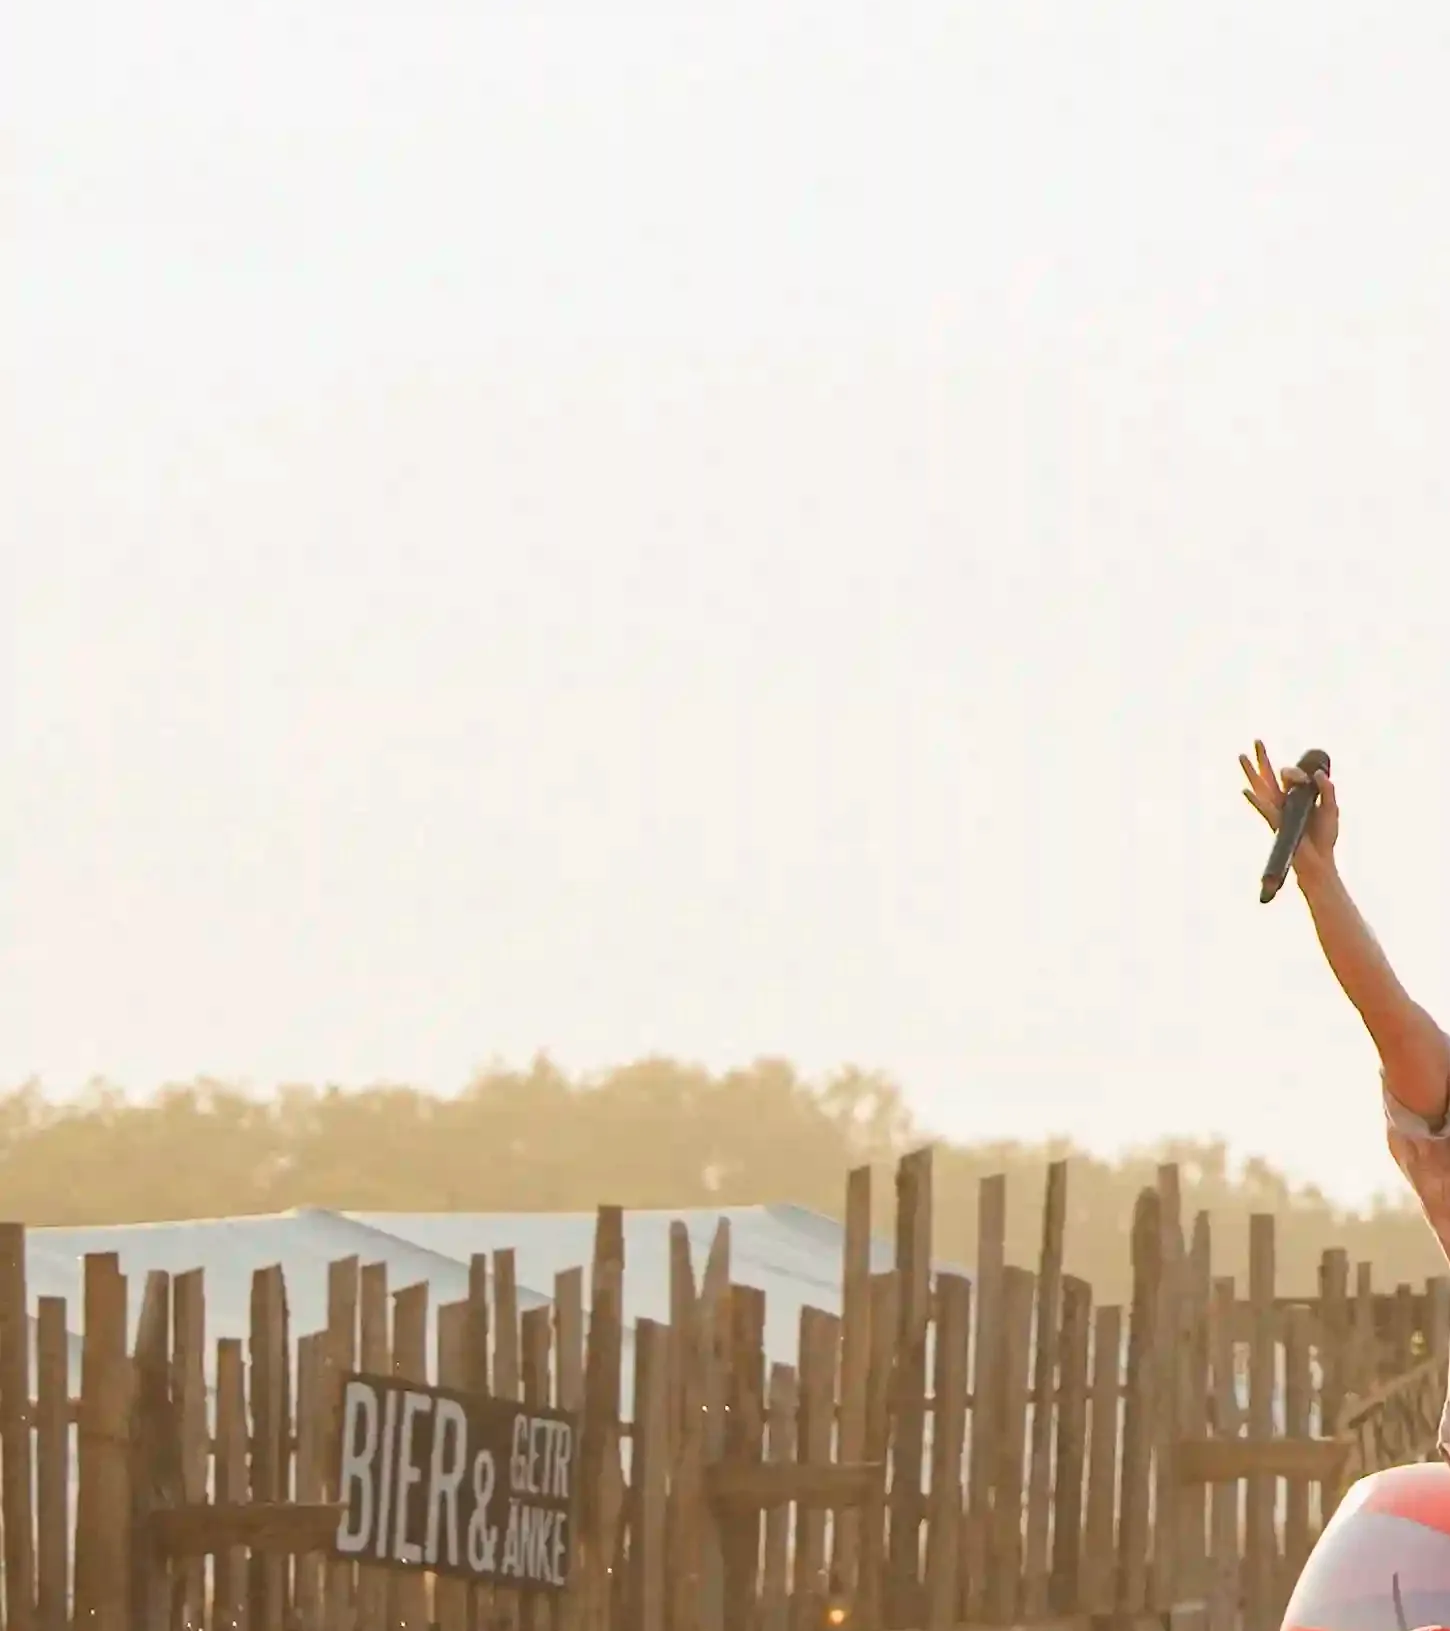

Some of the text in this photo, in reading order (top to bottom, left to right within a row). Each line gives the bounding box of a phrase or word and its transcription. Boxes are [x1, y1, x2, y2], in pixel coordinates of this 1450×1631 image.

[336, 1381, 498, 1573] BIER &
[509, 1413, 572, 1499] GETR
[502, 1497, 567, 1586] ÄNKE
